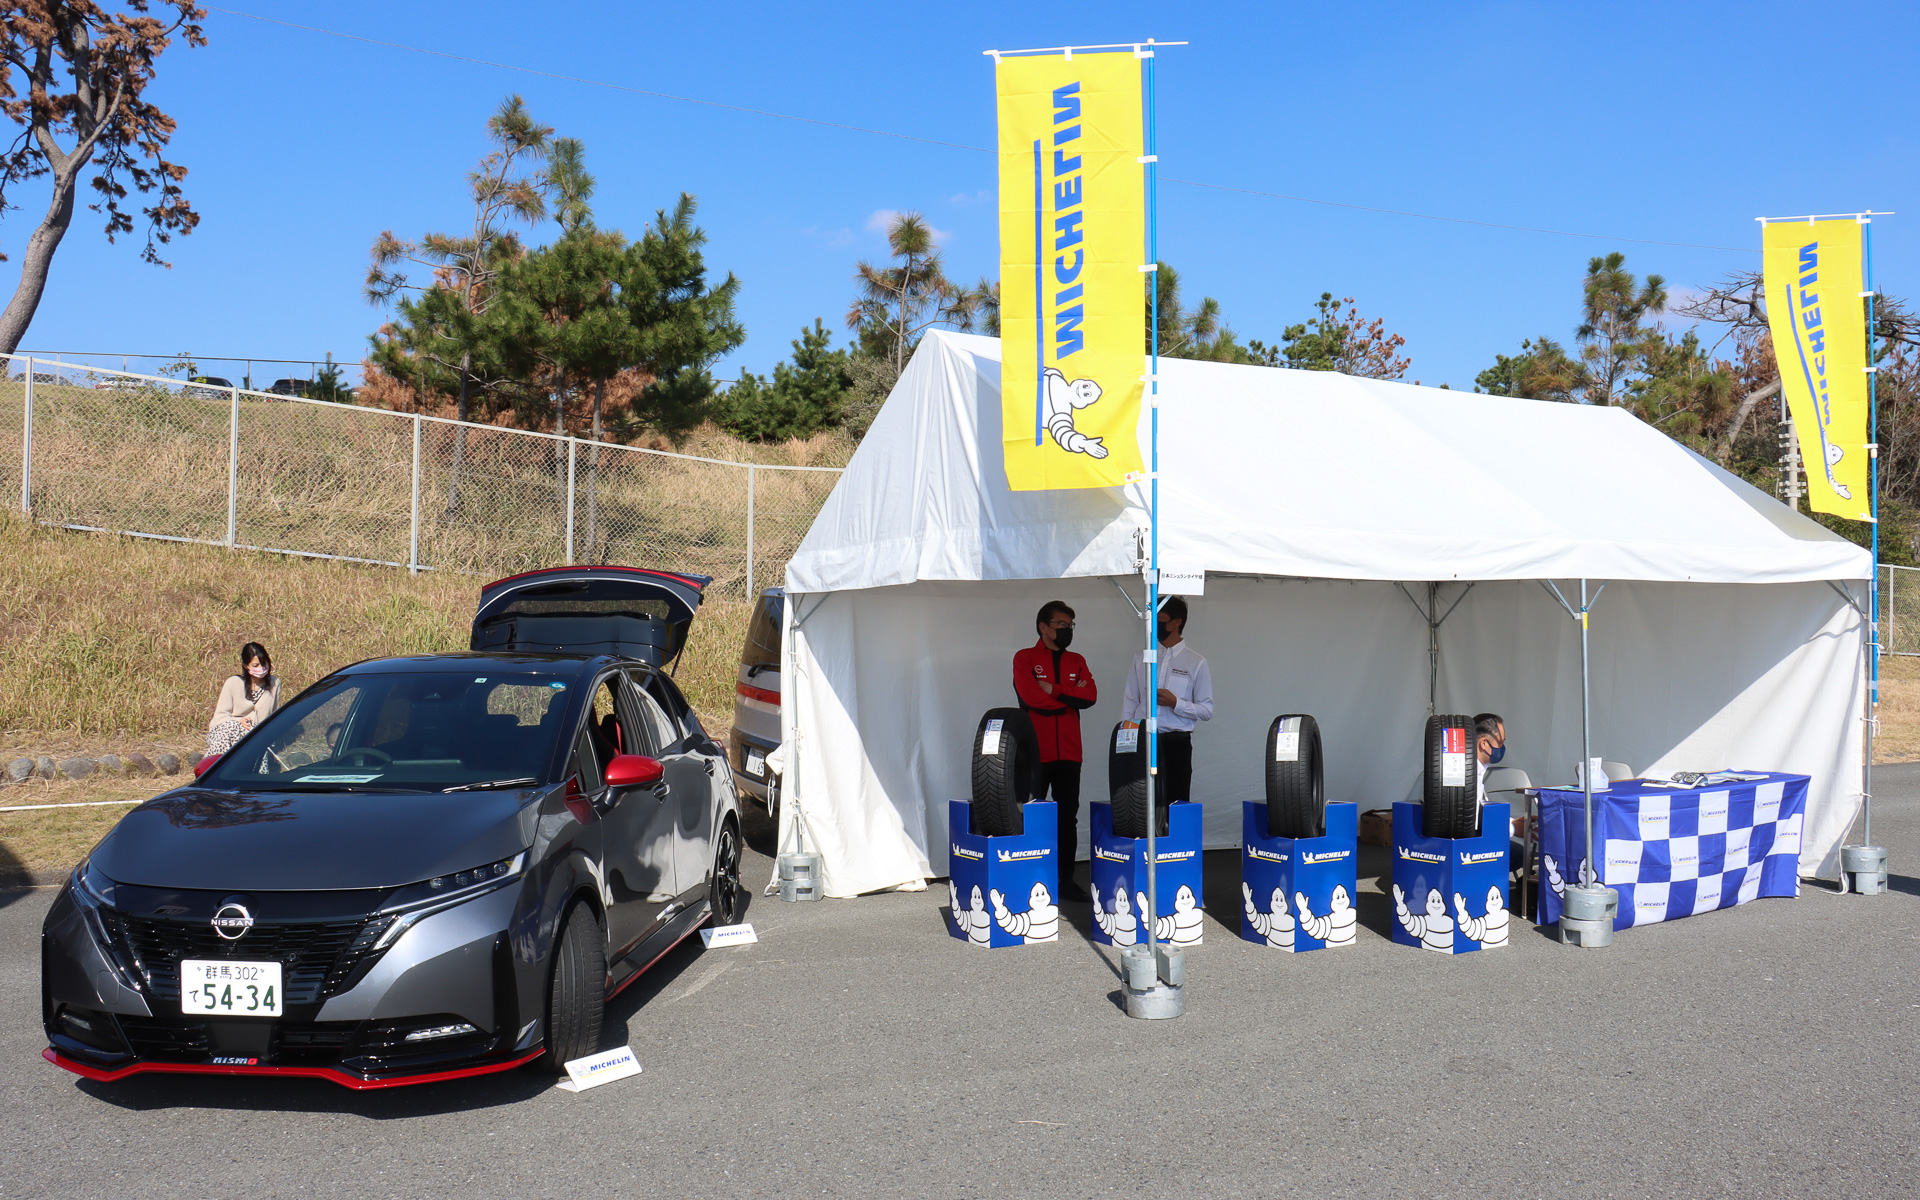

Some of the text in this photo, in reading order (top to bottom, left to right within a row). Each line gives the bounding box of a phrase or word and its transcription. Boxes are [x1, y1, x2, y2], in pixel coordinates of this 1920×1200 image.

[960, 848, 984, 859] MICHELIN
[1011, 848, 1050, 858] MICHELIN
[1103, 850, 1130, 861] MICHELIN
[1157, 850, 1196, 860] MICHELIN
[1257, 850, 1288, 861] MICHELIN
[1314, 850, 1350, 860] MICHELIN
[1410, 851, 1446, 862] MICHELIN
[1471, 850, 1504, 861] MICHELIN
[211, 918, 254, 927] NISSAN
[717, 929, 751, 938] MICHELIN
[204, 983, 276, 1012] 54-34
[590, 1055, 631, 1072] MICHELIN
